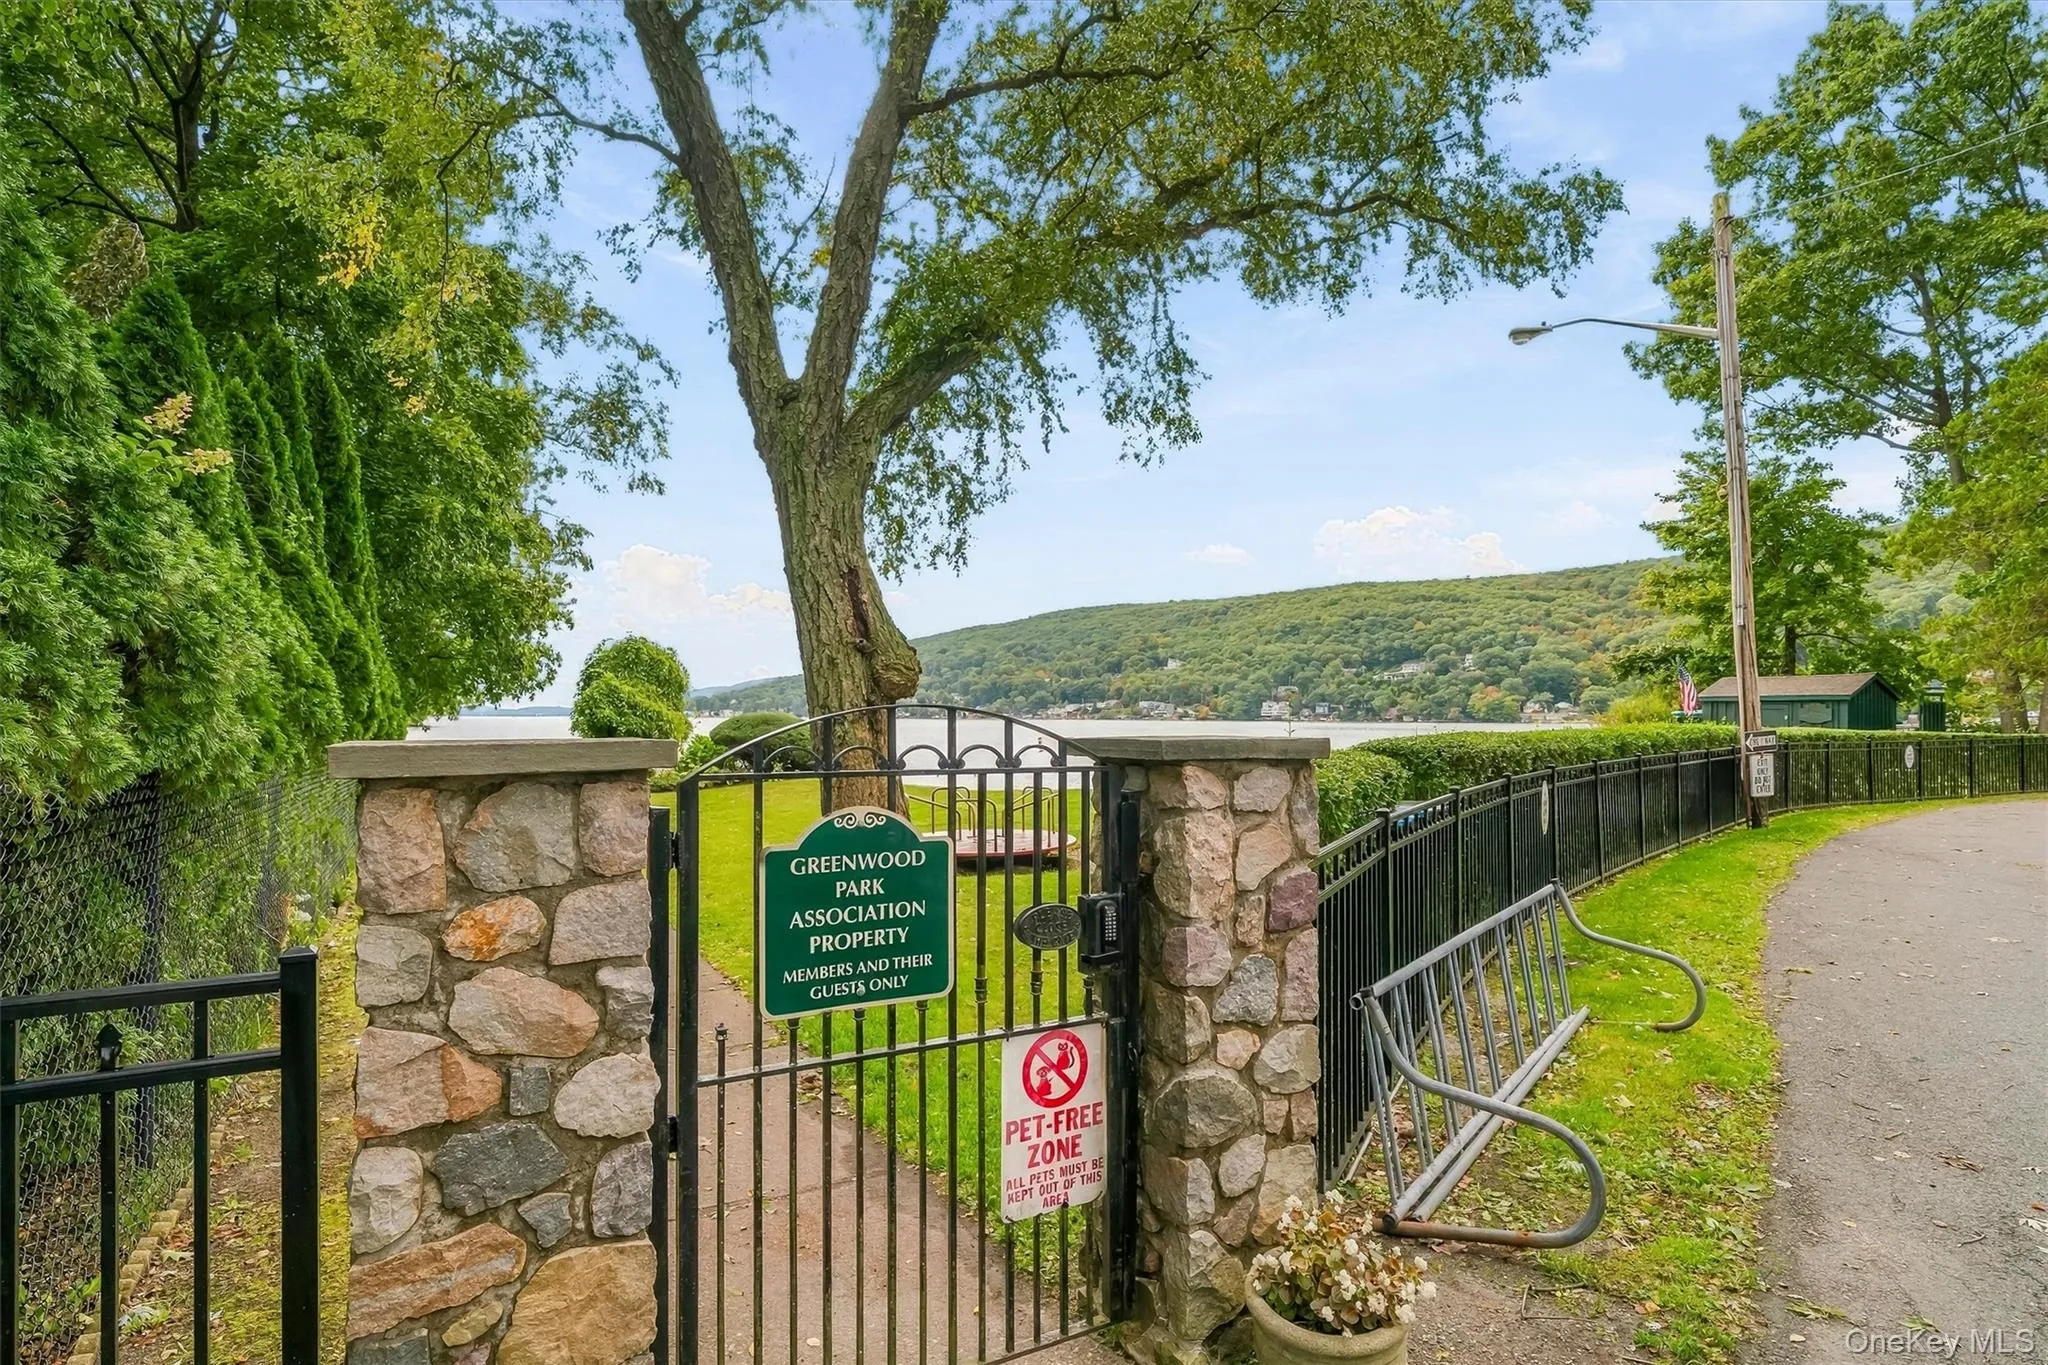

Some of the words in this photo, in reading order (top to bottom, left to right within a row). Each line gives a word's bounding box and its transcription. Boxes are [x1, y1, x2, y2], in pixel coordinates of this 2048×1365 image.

[790, 850, 926, 875] GREENWOOD
[836, 878, 885, 898] PARK
[789, 900, 926, 929] ASSOCIATION
[810, 927, 909, 954] PROPERTY
[783, 962, 853, 984] MEMBERS
[857, 958, 889, 974] AND
[893, 953, 933, 969] THEIR
[810, 979, 865, 1000] GUESTS
[870, 975, 909, 991] ONLY
[1005, 1101, 1104, 1146] PET-FREE
[1028, 1134, 1083, 1169] ZONE
[1006, 1176, 1025, 1192] ALL
[1030, 1170, 1055, 1187] PETS
[1060, 1160, 1088, 1178] MUST
[1092, 1157, 1104, 1170] BE
[1007, 1187, 1034, 1205] KEPT
[1039, 1181, 1059, 1197] OUT
[1064, 1177, 1076, 1190] OF
[1080, 1170, 1102, 1186] THIS
[1042, 1191, 1070, 1209] AREA
